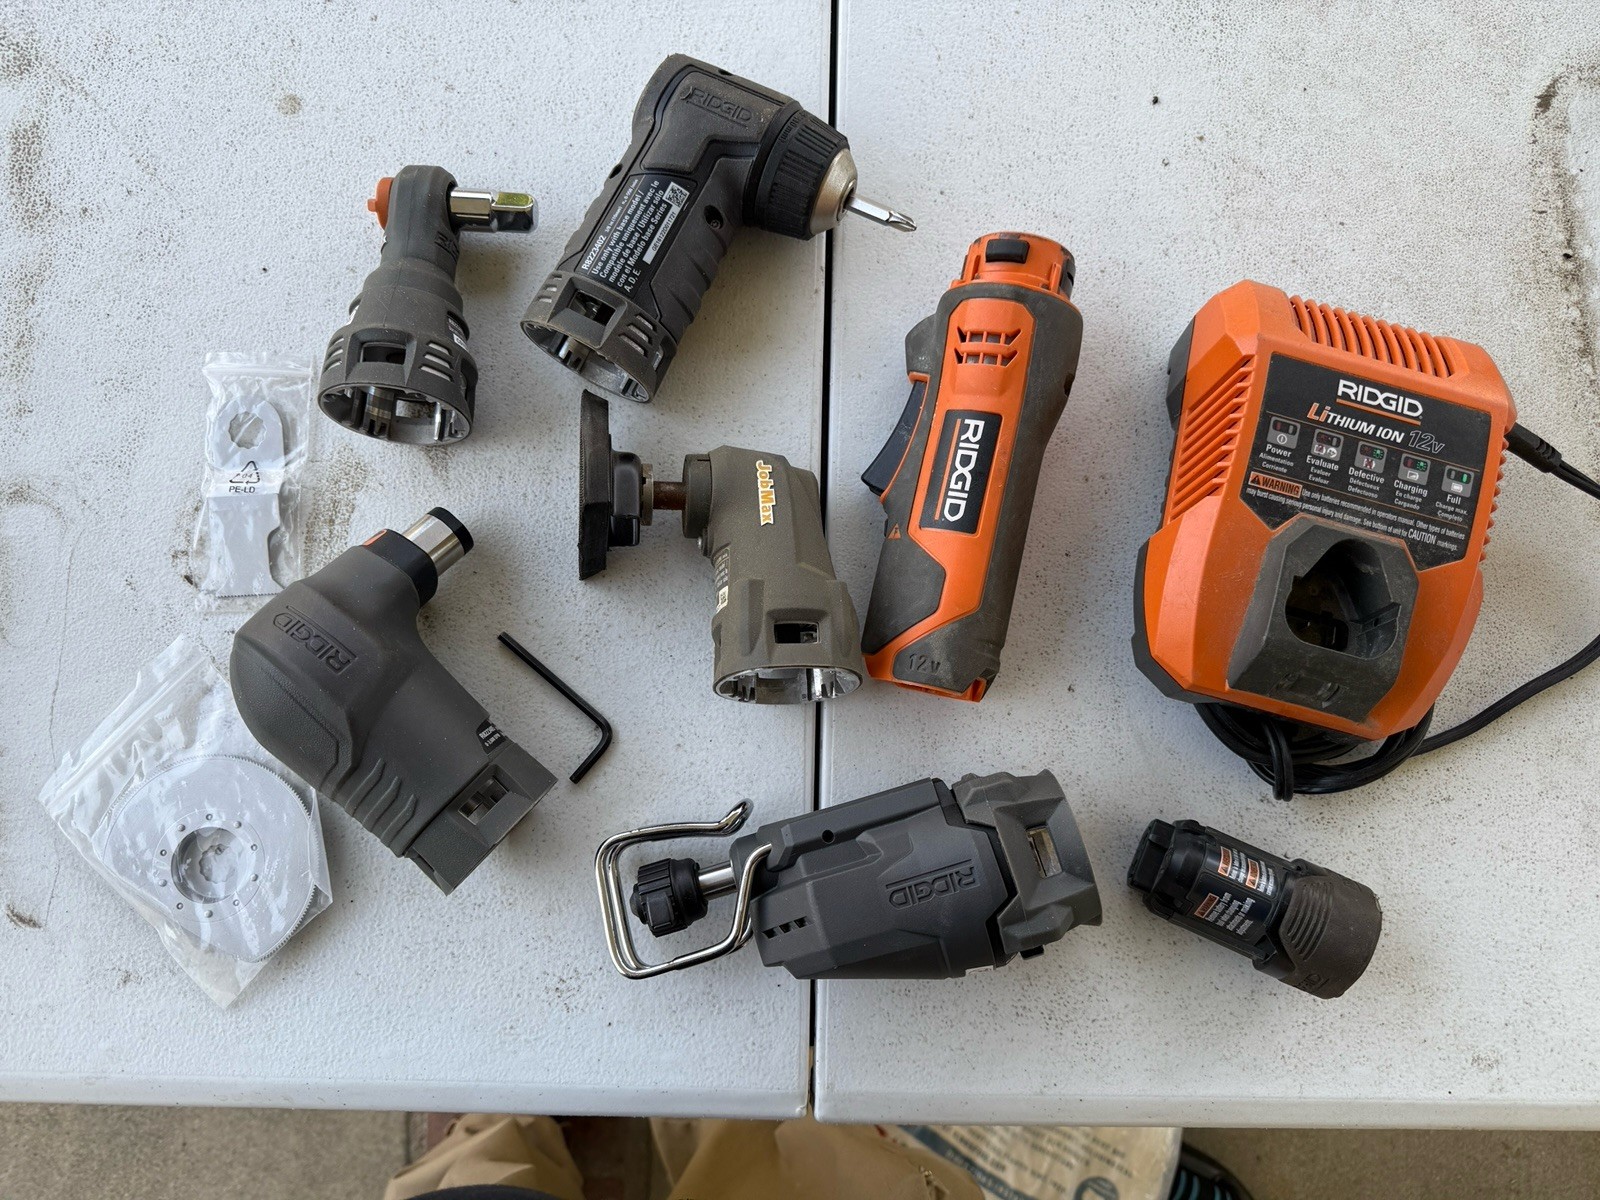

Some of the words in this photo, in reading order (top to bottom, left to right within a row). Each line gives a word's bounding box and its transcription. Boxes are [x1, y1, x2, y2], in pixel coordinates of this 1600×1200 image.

[690, 86, 753, 121] RIDGID
[650, 202, 667, 224] Series
[621, 248, 630, 257] de
[626, 231, 640, 248] base
[637, 203, 655, 228] Utilizar
[652, 189, 664, 204] sólo
[591, 261, 603, 274] Use
[600, 245, 613, 261] only
[608, 231, 620, 246] with
[616, 214, 629, 230] base
[627, 193, 641, 214] model
[598, 241, 624, 278] Compatible
[621, 203, 646, 241] uniquement
[643, 187, 655, 203] avec
[640, 223, 655, 241] base
[626, 240, 645, 266] Modelo
[624, 264, 631, 273] el
[617, 273, 627, 287] con
[1337, 379, 1423, 417] RIDGID
[1375, 426, 1404, 443] ION
[1265, 443, 1291, 457] Power
[1258, 452, 1294, 466] Alimentation
[1261, 461, 1287, 473] Corriente
[1305, 454, 1338, 470] Evaluate
[941, 418, 985, 522] RIDGID
[1310, 466, 1330, 476] Evaluer
[1348, 466, 1384, 483] Defective
[1308, 474, 1329, 484] Evaluar
[228, 485, 255, 493] PE-LD
[755, 459, 779, 525] JobMax
[1347, 484, 1378, 498] Defectuoso
[1393, 479, 1428, 497] Charging
[1393, 497, 1420, 510] Cargando
[1402, 493, 1422, 502] charge
[1435, 501, 1454, 511] Charge
[1446, 493, 1461, 504] Full
[1245, 487, 1256, 496] may
[1256, 489, 1268, 498] burst
[1267, 493, 1285, 504] causing
[1285, 498, 1302, 508] serious
[1301, 502, 1321, 512] personal
[1321, 506, 1334, 517] injury
[1334, 511, 1343, 519] and
[1362, 518, 1371, 526] See
[1371, 520, 1387, 531] bottom
[1407, 528, 1436, 544] CAUTION
[1260, 476, 1301, 496] WARNING
[1301, 488, 1310, 497] Use
[1310, 492, 1321, 501] only
[1320, 494, 1340, 505] batteries
[1339, 500, 1371, 514] recommended
[1415, 520, 1428, 529] Other
[1428, 524, 1440, 533] types
[1445, 528, 1465, 539] batteries
[1436, 510, 1462, 522] Completo
[271, 611, 352, 675] RIDGID
[888, 866, 977, 910] RIDGID
